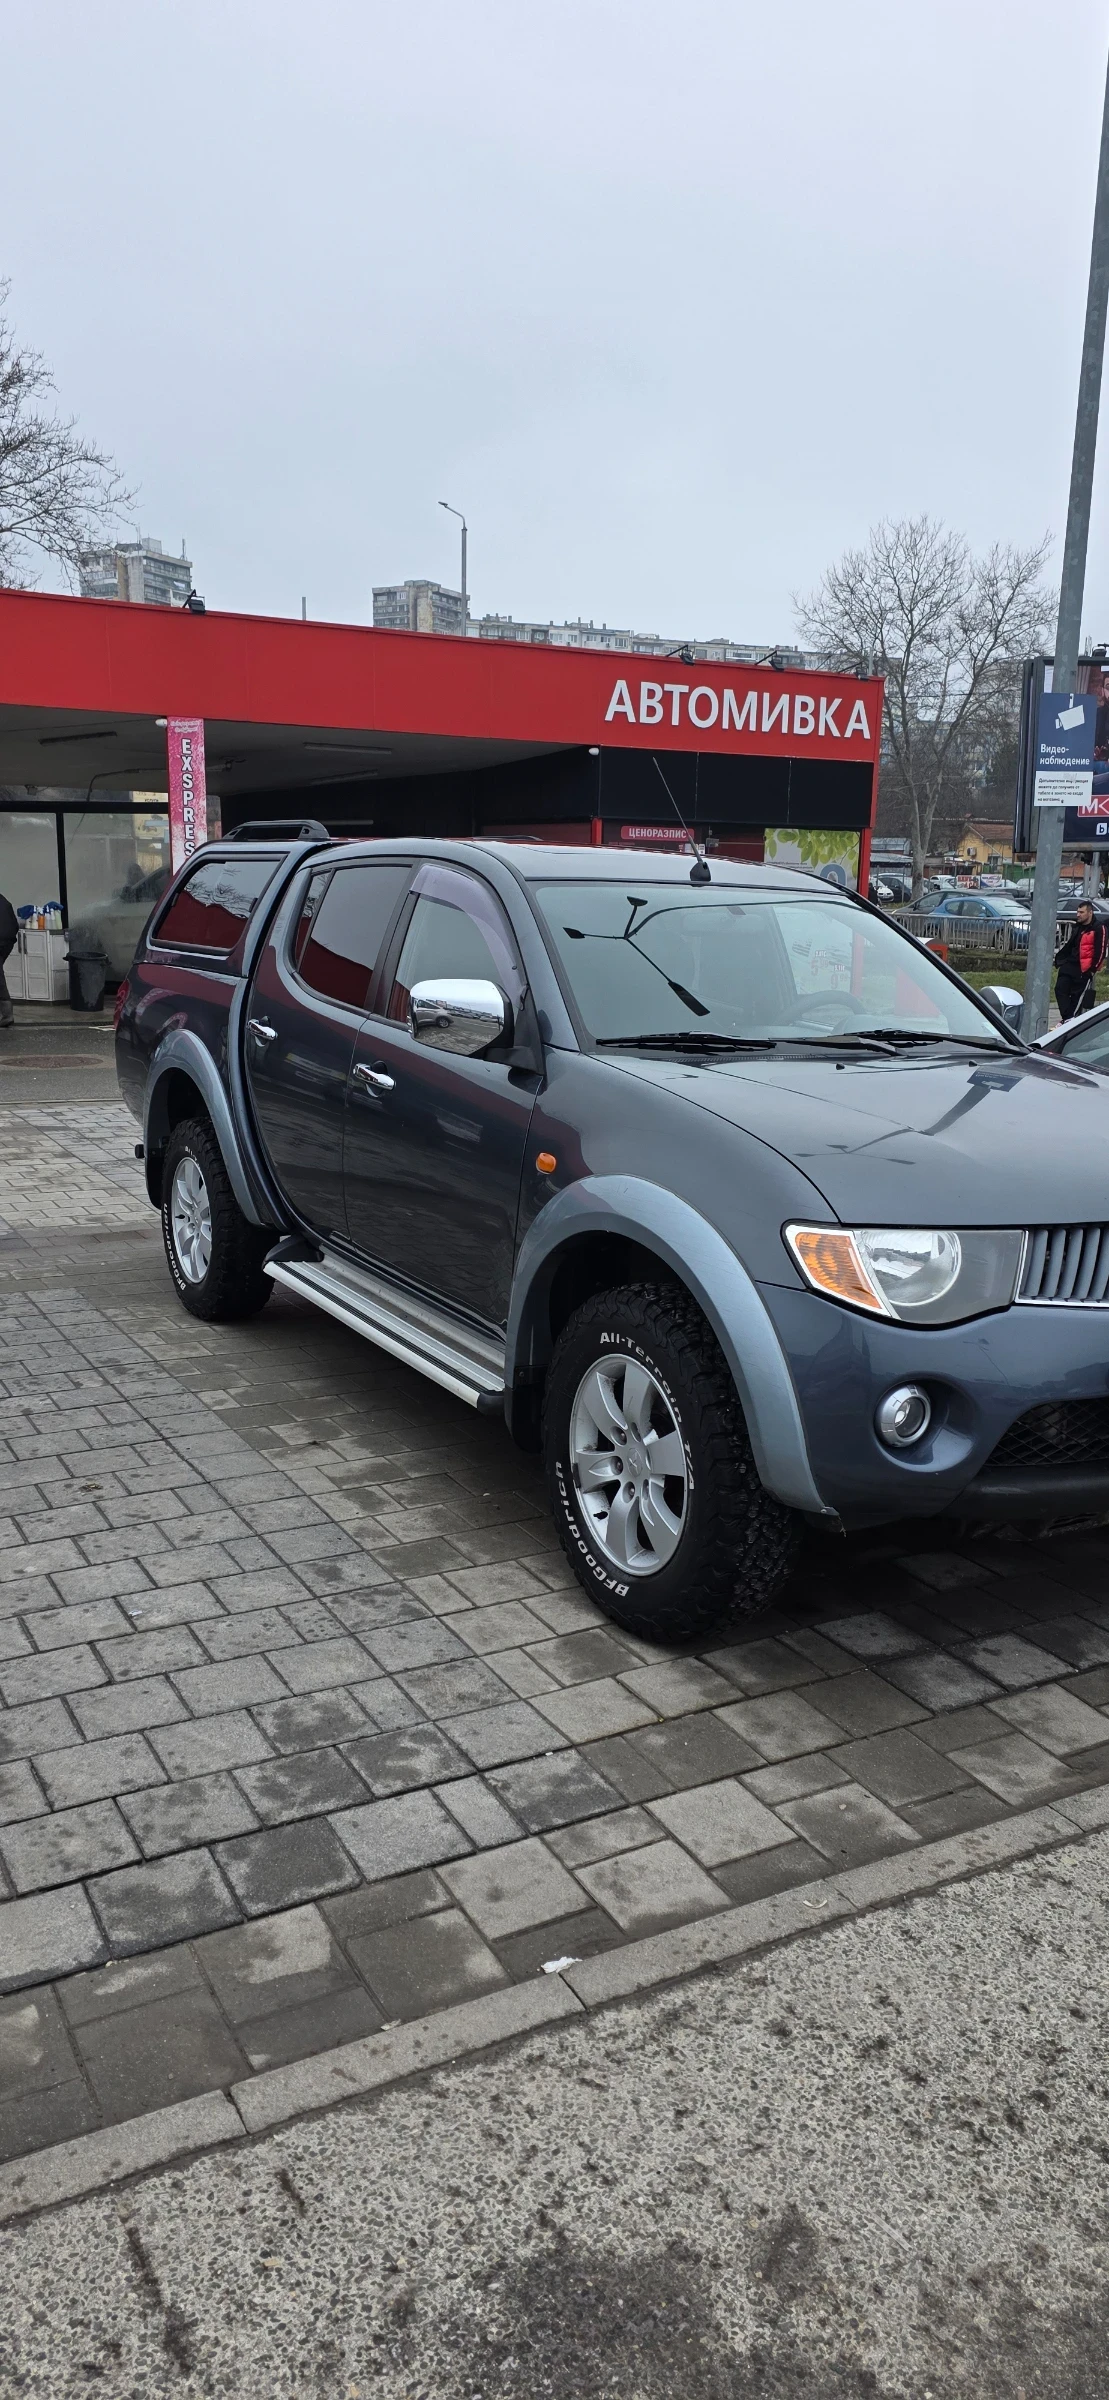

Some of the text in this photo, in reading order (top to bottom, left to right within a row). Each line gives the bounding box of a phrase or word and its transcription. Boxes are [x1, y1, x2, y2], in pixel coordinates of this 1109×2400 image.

[604, 679, 871, 740] АВТОМИВКА
[1039, 755, 1090, 766] наблюдение
[1040, 743, 1069, 755] Видео-
[628, 827, 687, 839] ЦЕНОРАЗПИС
[600, 1331, 682, 1423] All-Terrain
[555, 1461, 630, 1597] BFGoodrich
